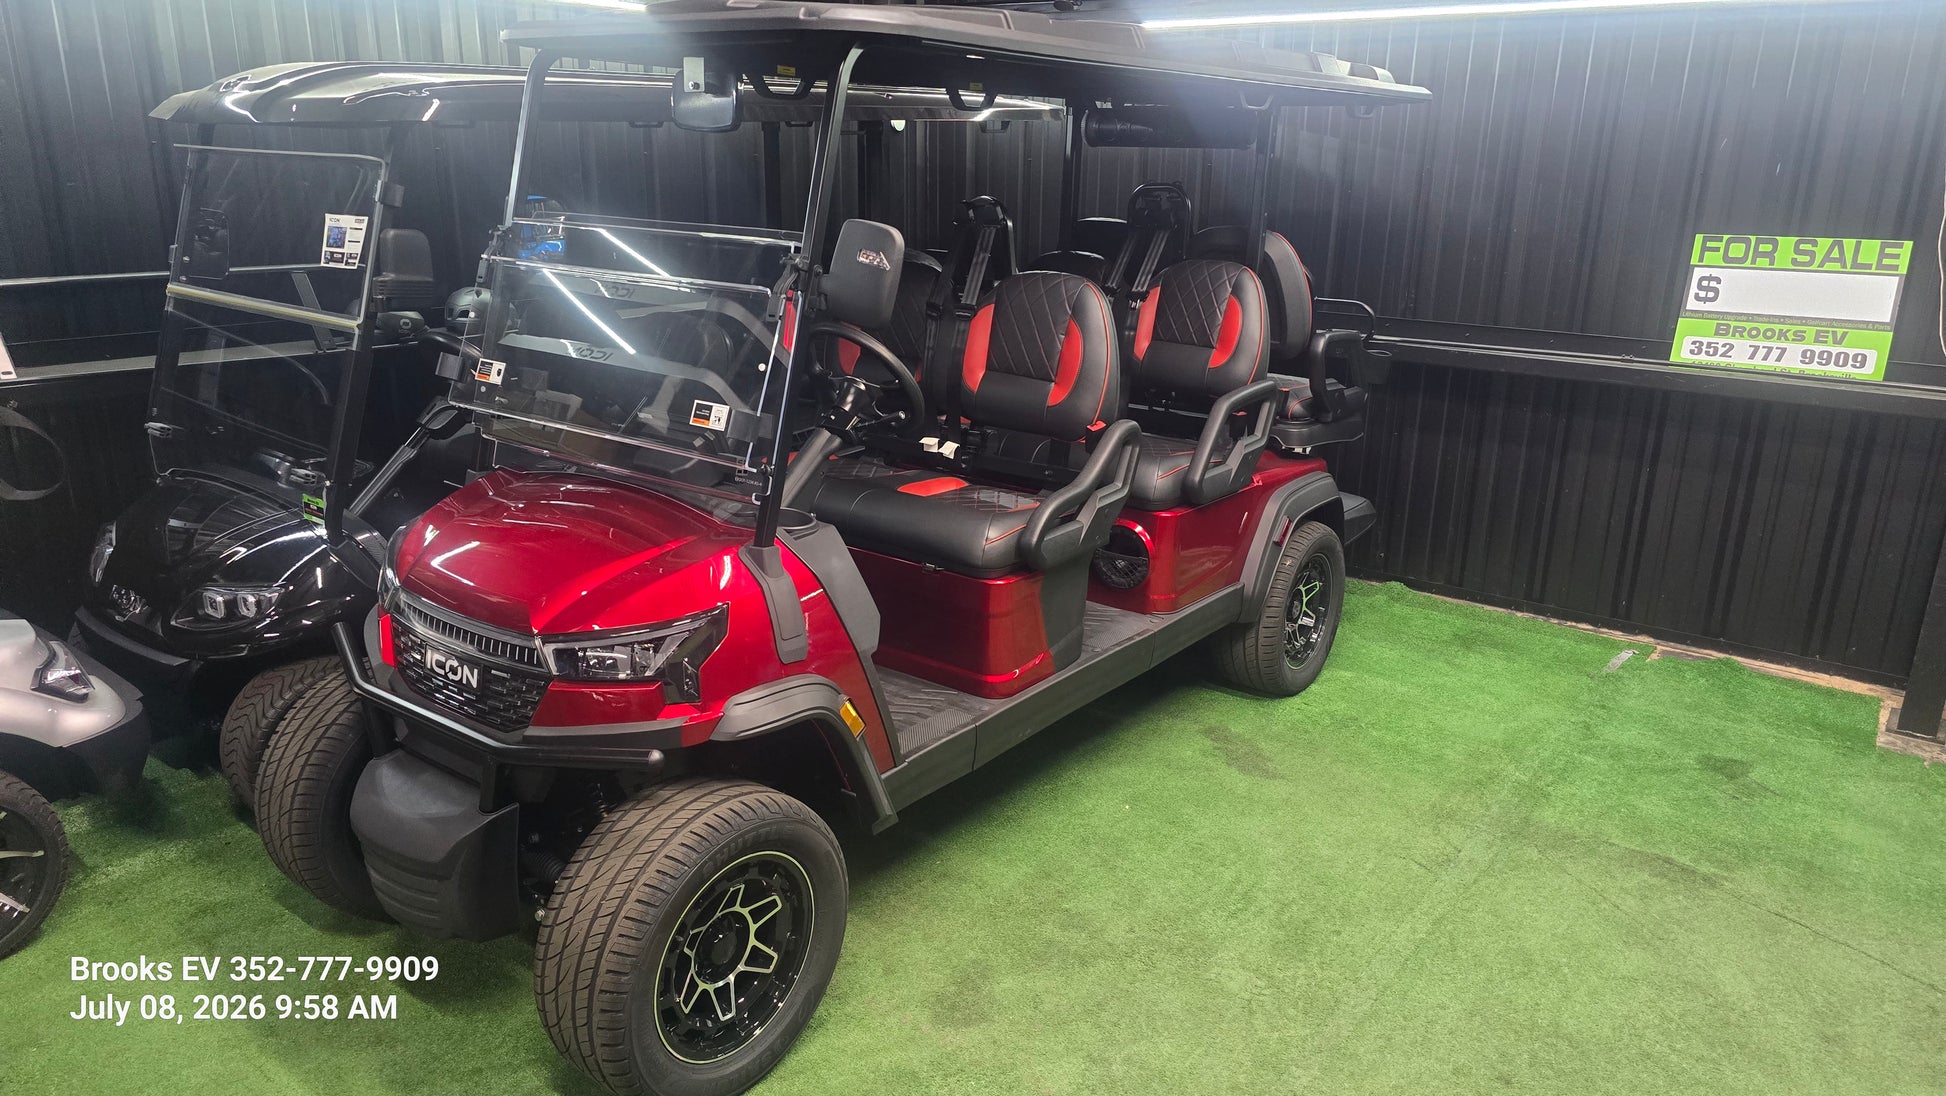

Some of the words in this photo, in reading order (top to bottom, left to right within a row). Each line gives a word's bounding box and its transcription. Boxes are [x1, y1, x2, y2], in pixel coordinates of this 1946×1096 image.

[1697, 235, 1779, 267] FOR
[1791, 238, 1904, 271] SALE
[1693, 273, 1722, 304] $
[1714, 322, 1807, 342] BROOKS
[1813, 328, 1849, 346] EV
[1689, 340, 1735, 358] 352
[1747, 344, 1788, 363] 777
[1799, 348, 1868, 369] 9909
[426, 649, 478, 689] ICON
